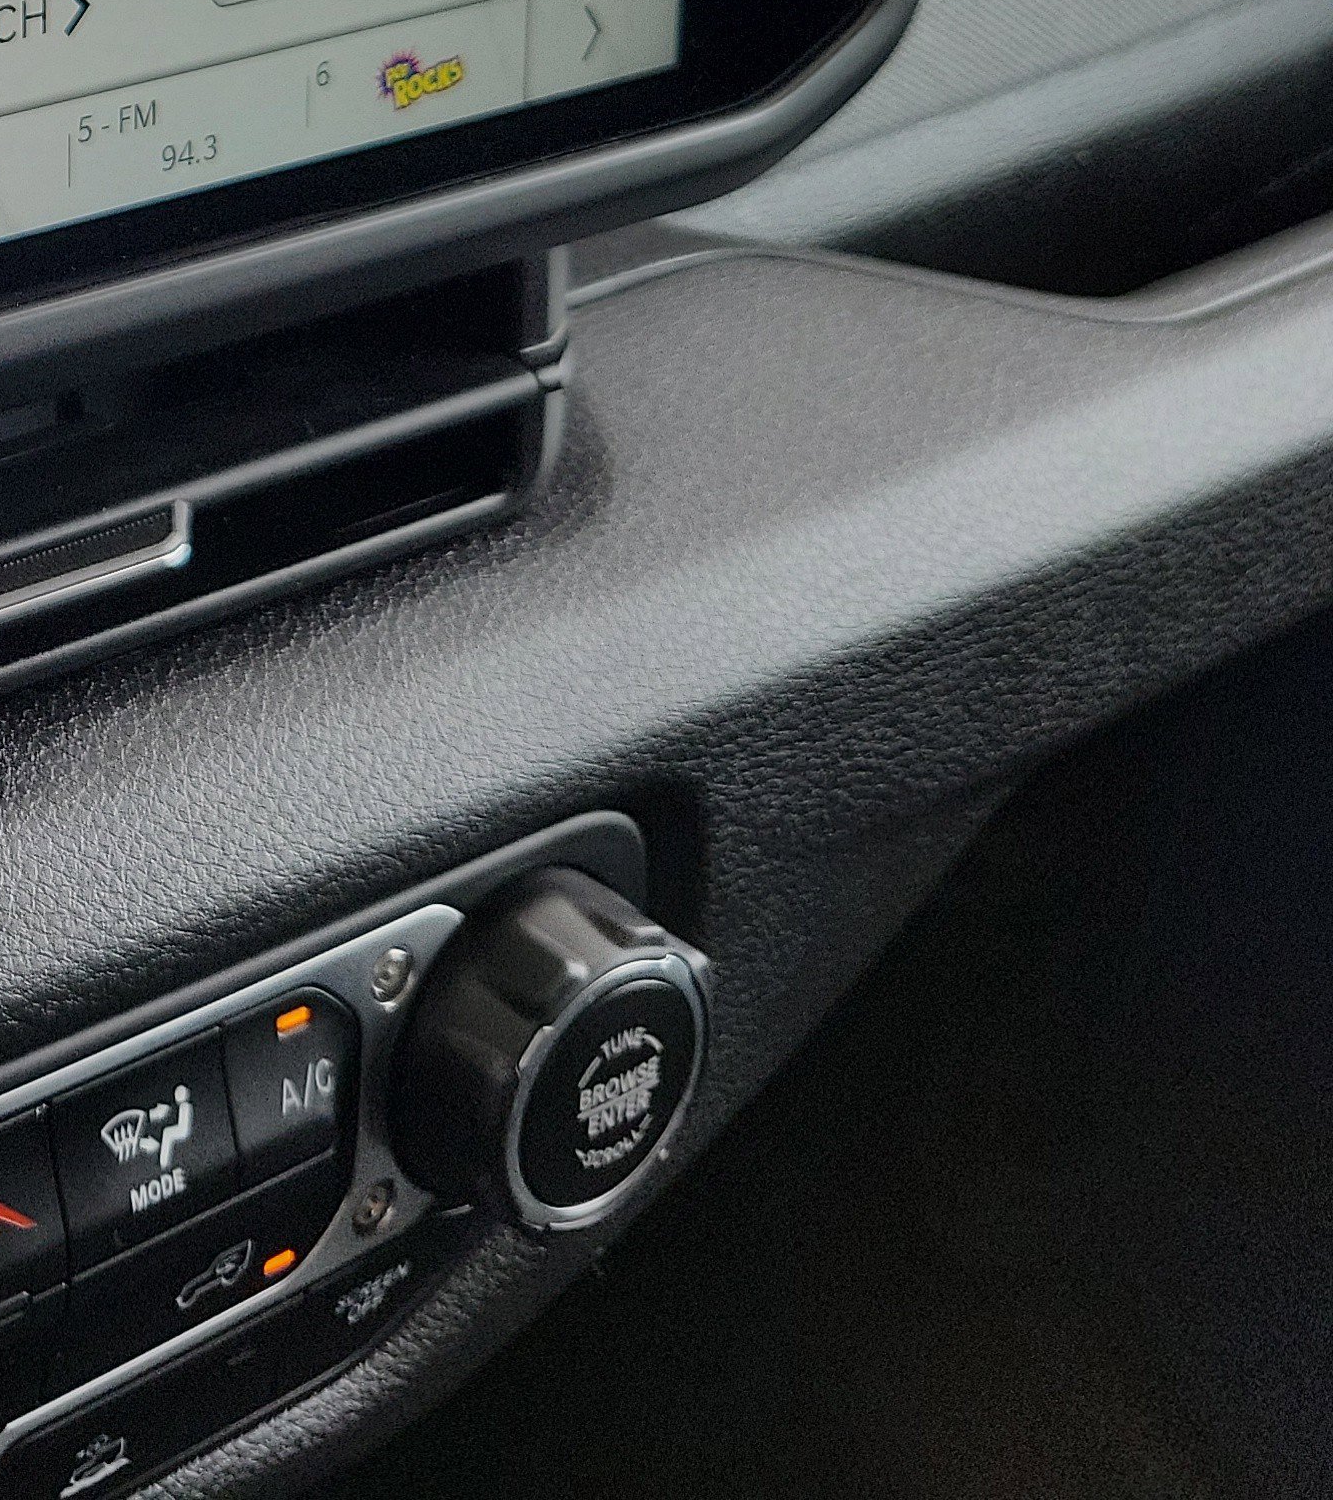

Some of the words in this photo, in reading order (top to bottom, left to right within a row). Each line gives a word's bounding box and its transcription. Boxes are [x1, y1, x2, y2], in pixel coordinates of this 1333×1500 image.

[315, 59, 330, 88] 6
[78, 114, 93, 144] 5
[119, 99, 158, 135] FM
[161, 134, 218, 173] 94.3
[600, 1026, 647, 1061] TUNE
[282, 1057, 333, 1116] A/C
[579, 1054, 660, 1112] BROWSE
[588, 1089, 652, 1138] ENTER
[130, 1168, 188, 1214] MODE
